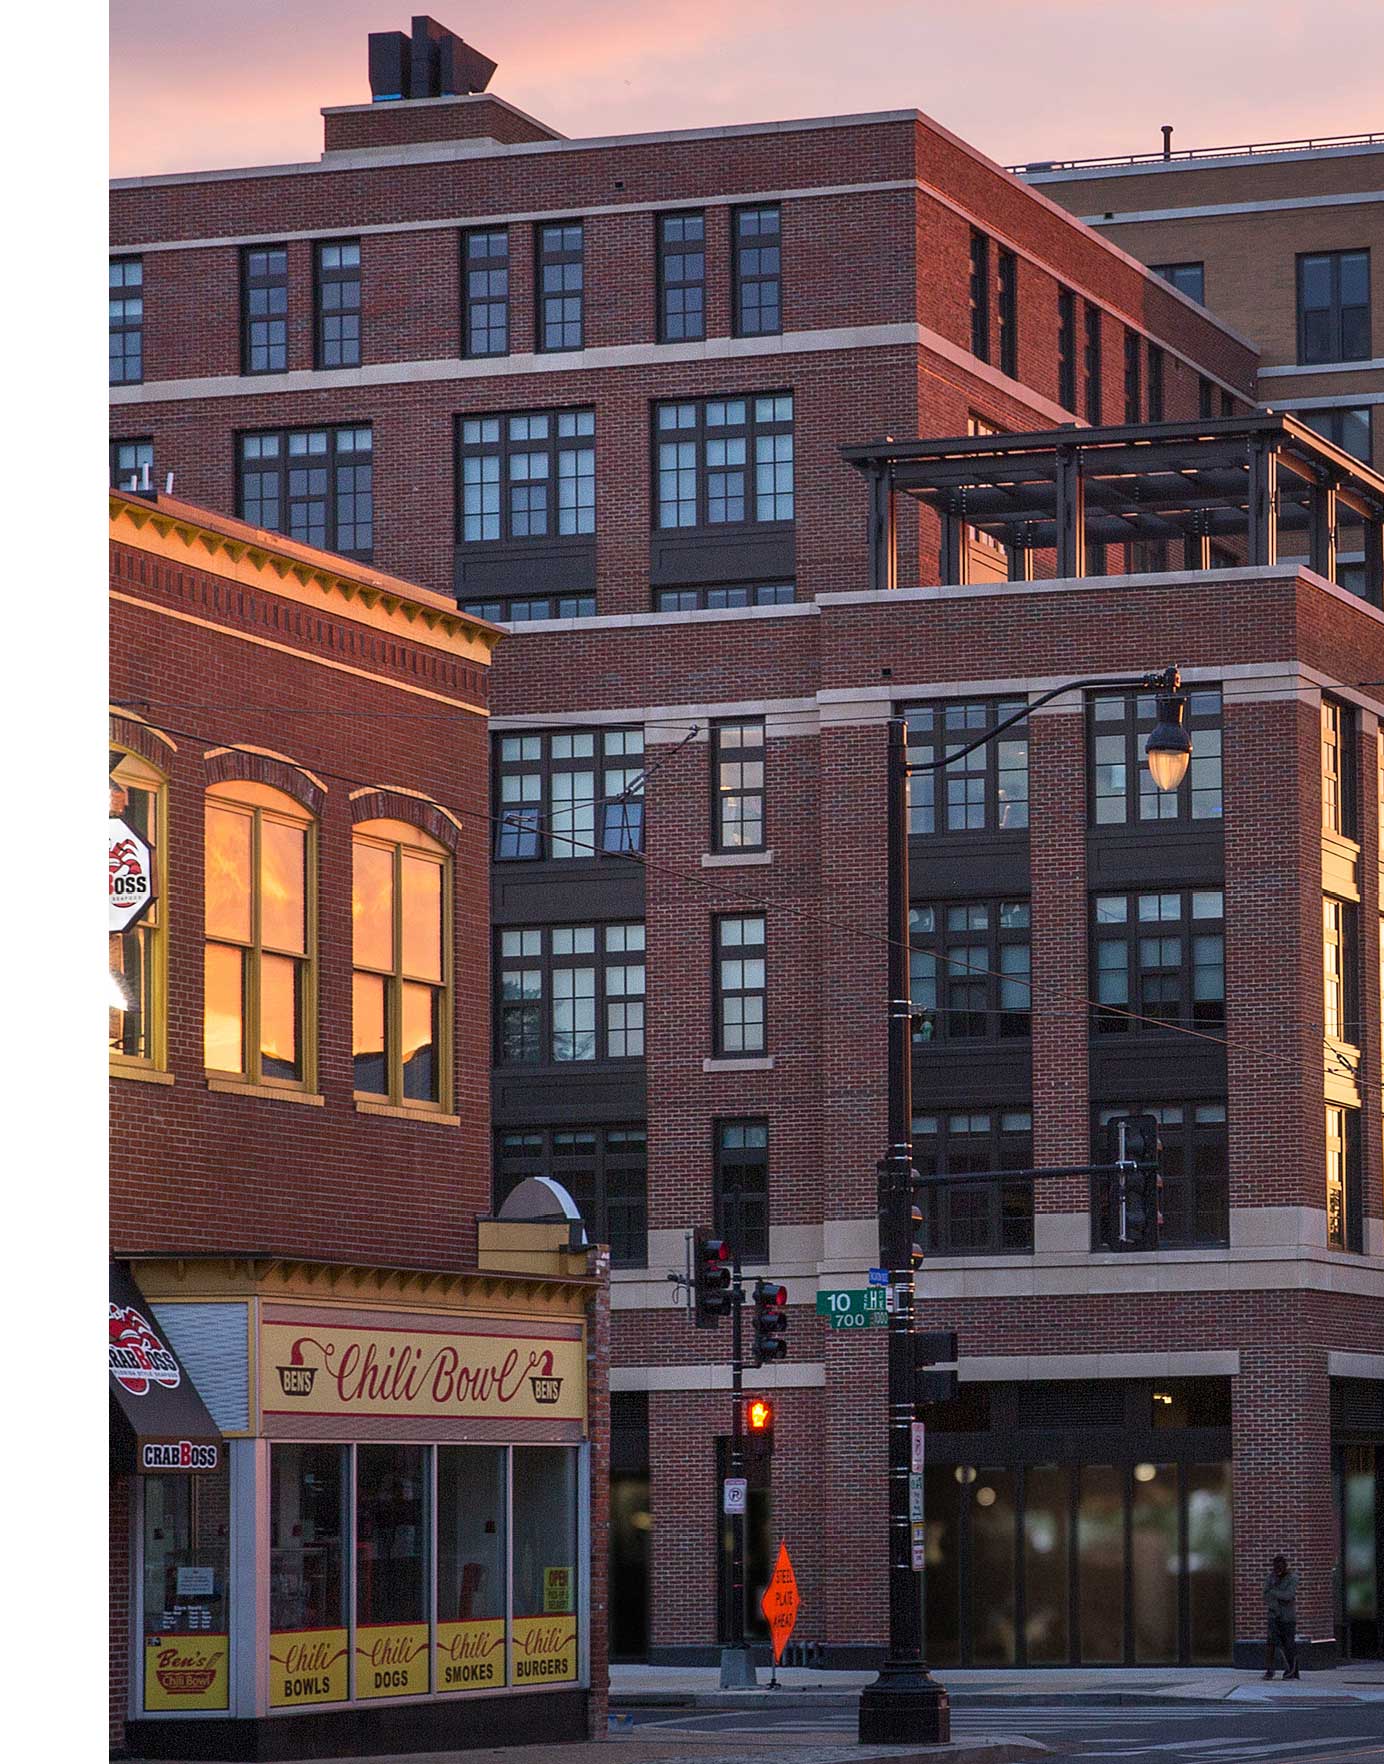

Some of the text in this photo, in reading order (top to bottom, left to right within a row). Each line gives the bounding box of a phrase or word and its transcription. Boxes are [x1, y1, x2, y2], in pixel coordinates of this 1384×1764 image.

[835, 1313, 865, 1327] 700
[109, 1344, 178, 1371] RABBOSS
[329, 1343, 522, 1402] Chili Bowl
[549, 1570, 569, 1586] OPEN
[776, 1569, 793, 1584] STEEL
[775, 1591, 793, 1606] PLATE
[773, 1613, 793, 1628] AHEAD
[450, 1632, 490, 1661] Chili
[525, 1627, 562, 1656] Chili
[157, 1648, 207, 1668] Ben's
[286, 1642, 331, 1674] Chili
[371, 1637, 413, 1667] Chili
[445, 1663, 494, 1684] SMOKES
[516, 1658, 569, 1677] BURGERS
[163, 1673, 210, 1687] Chili Bowl
[284, 1676, 330, 1697] BOWLS
[374, 1670, 408, 1689] DOGS
